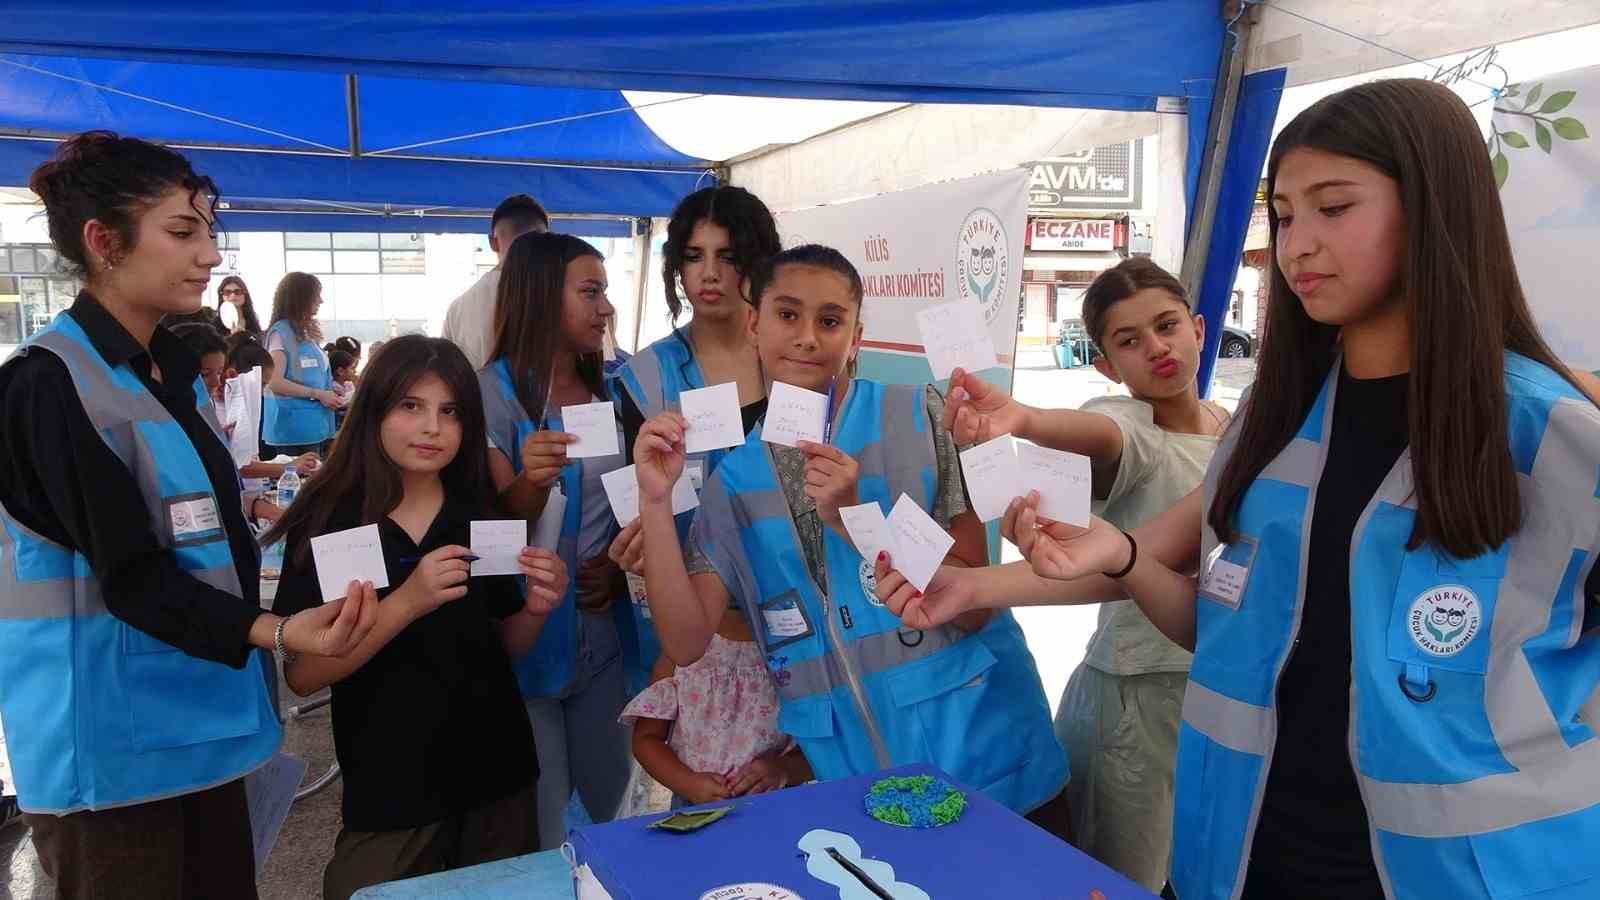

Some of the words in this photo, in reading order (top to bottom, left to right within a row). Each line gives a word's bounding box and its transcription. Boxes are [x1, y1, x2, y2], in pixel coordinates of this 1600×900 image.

[1035, 222, 1110, 239] ECZANE
[864, 233, 889, 263] KİLİS
[862, 275, 897, 297] AKLARI
[897, 266, 944, 297] KOMİTESİ
